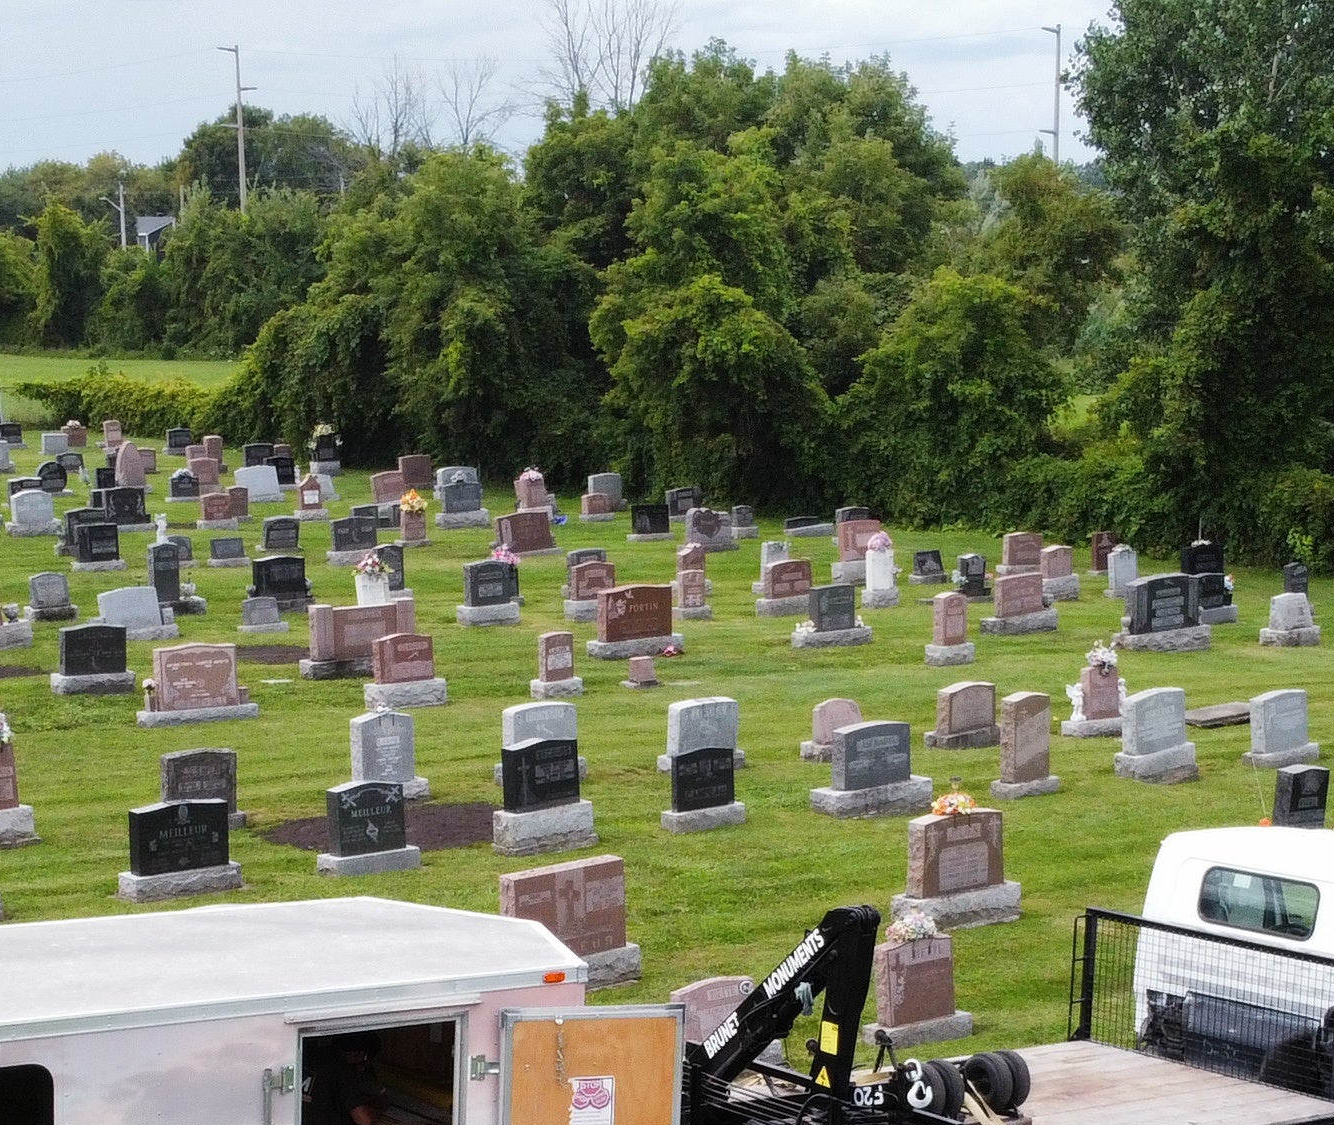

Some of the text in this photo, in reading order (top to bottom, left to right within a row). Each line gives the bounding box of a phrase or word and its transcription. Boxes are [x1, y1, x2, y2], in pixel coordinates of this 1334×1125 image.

[629, 602, 659, 612] FORTIN
[351, 805, 393, 818] MEILLEUR
[159, 824, 209, 839] MEILLEUR
[703, 928, 825, 1059] BRUNET MONUMENTS
